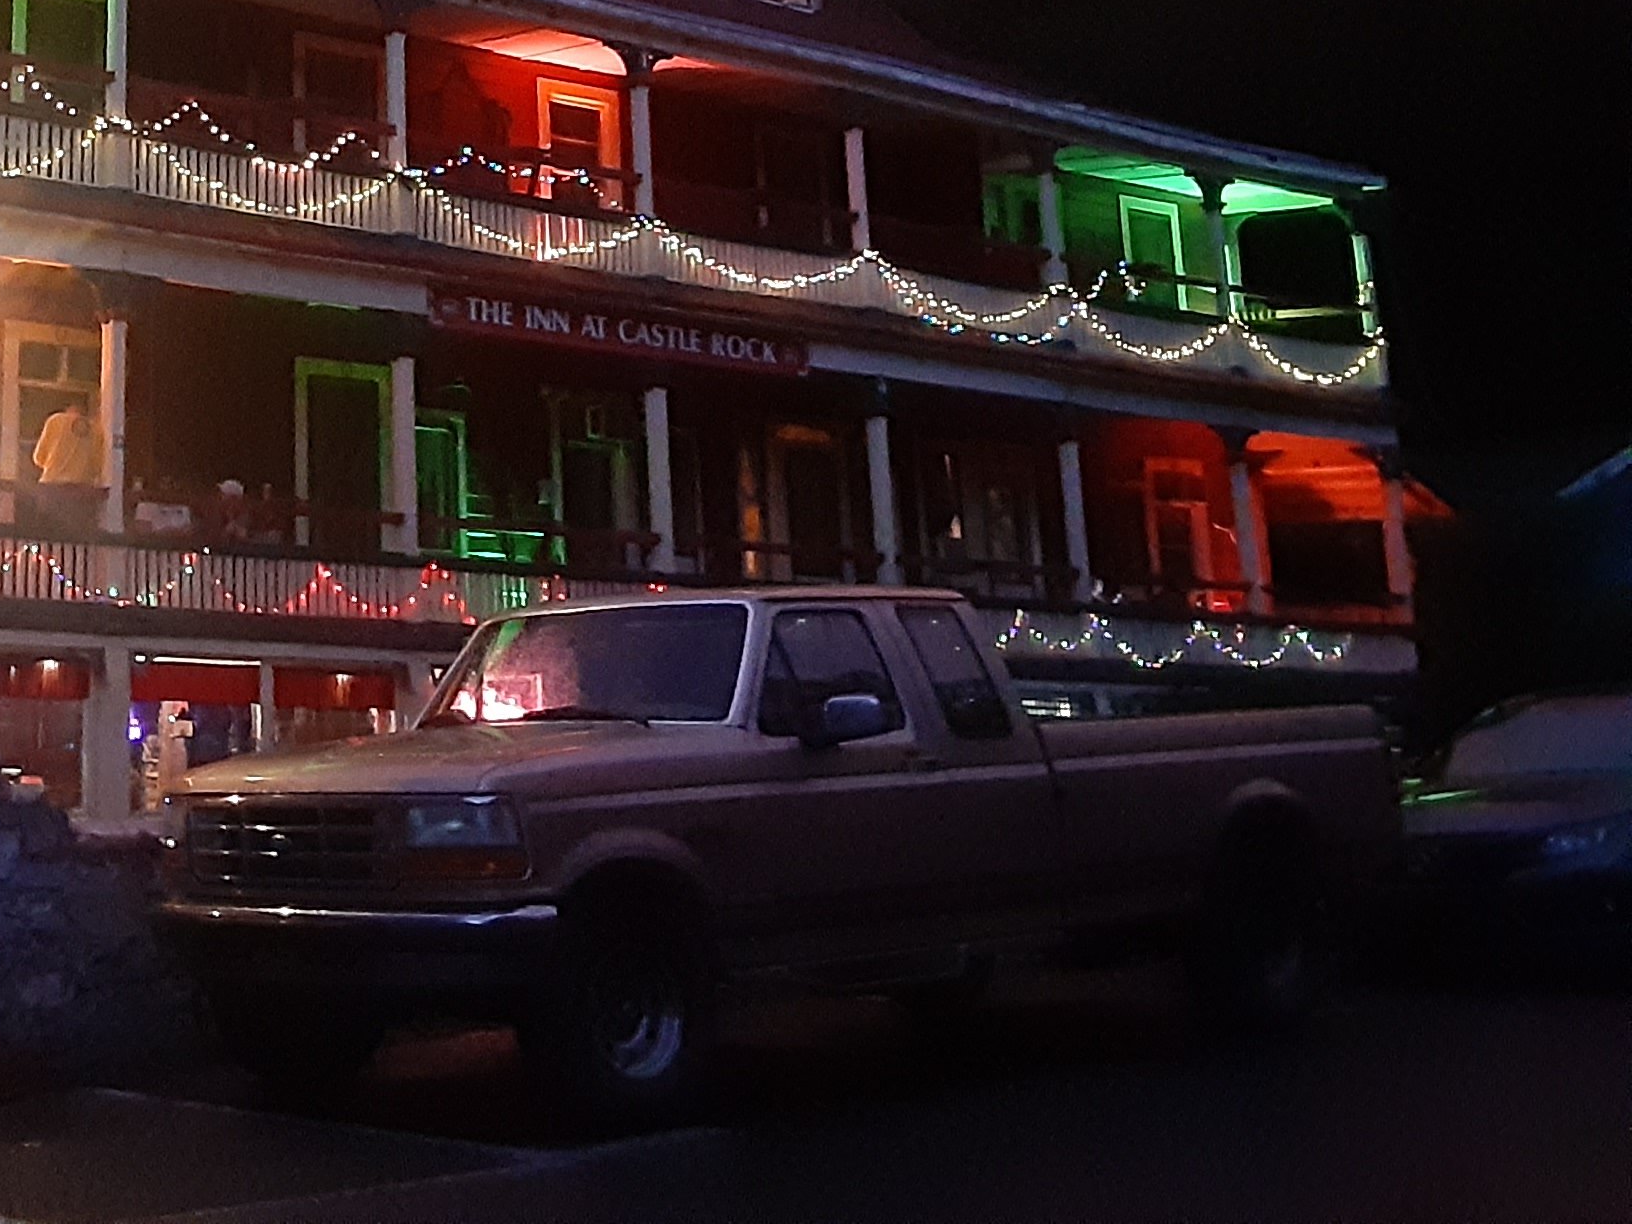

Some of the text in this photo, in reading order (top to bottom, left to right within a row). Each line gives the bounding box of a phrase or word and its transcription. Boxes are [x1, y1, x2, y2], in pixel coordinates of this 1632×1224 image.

[466, 296, 777, 364] THE INN AT CASTLE ROCK
